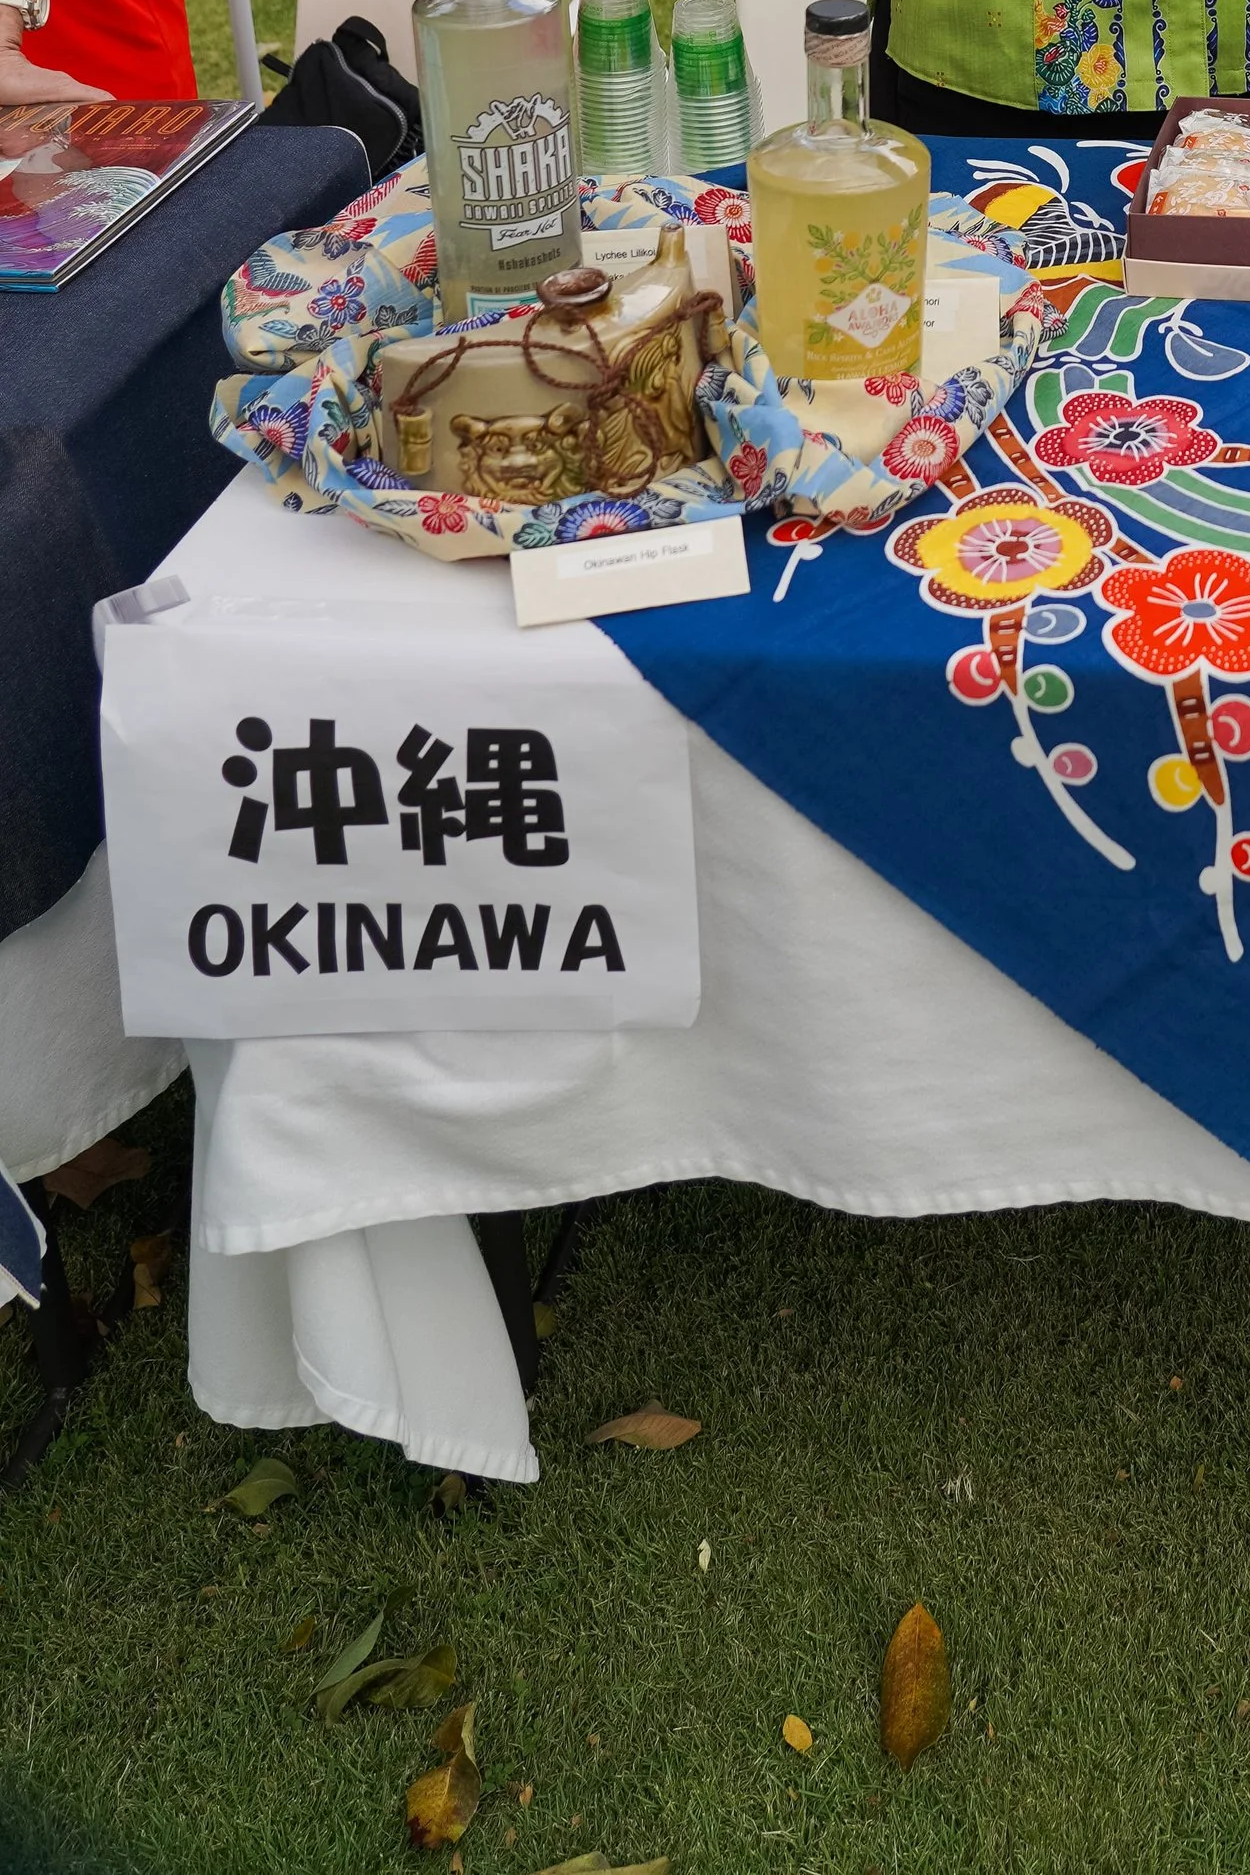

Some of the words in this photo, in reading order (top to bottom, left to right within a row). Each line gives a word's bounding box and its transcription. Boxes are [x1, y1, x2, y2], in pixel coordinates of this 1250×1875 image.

[0, 104, 205, 135] MOTARO
[458, 123, 573, 201] SHAKA
[464, 202, 524, 221] HAWAII
[528, 180, 575, 216] SPIRITS
[497, 227, 532, 242] Fear
[532, 217, 559, 237] Not
[595, 250, 628, 262] Lychee
[630, 247, 656, 258] Lilikoi
[848, 300, 898, 322] ALOHA
[583, 552, 637, 571] Okinawan
[639, 549, 658, 561] Hip
[662, 543, 689, 556] Flask
[220, 715, 570, 868] 沖縄
[187, 901, 627, 978] OKINAWA
